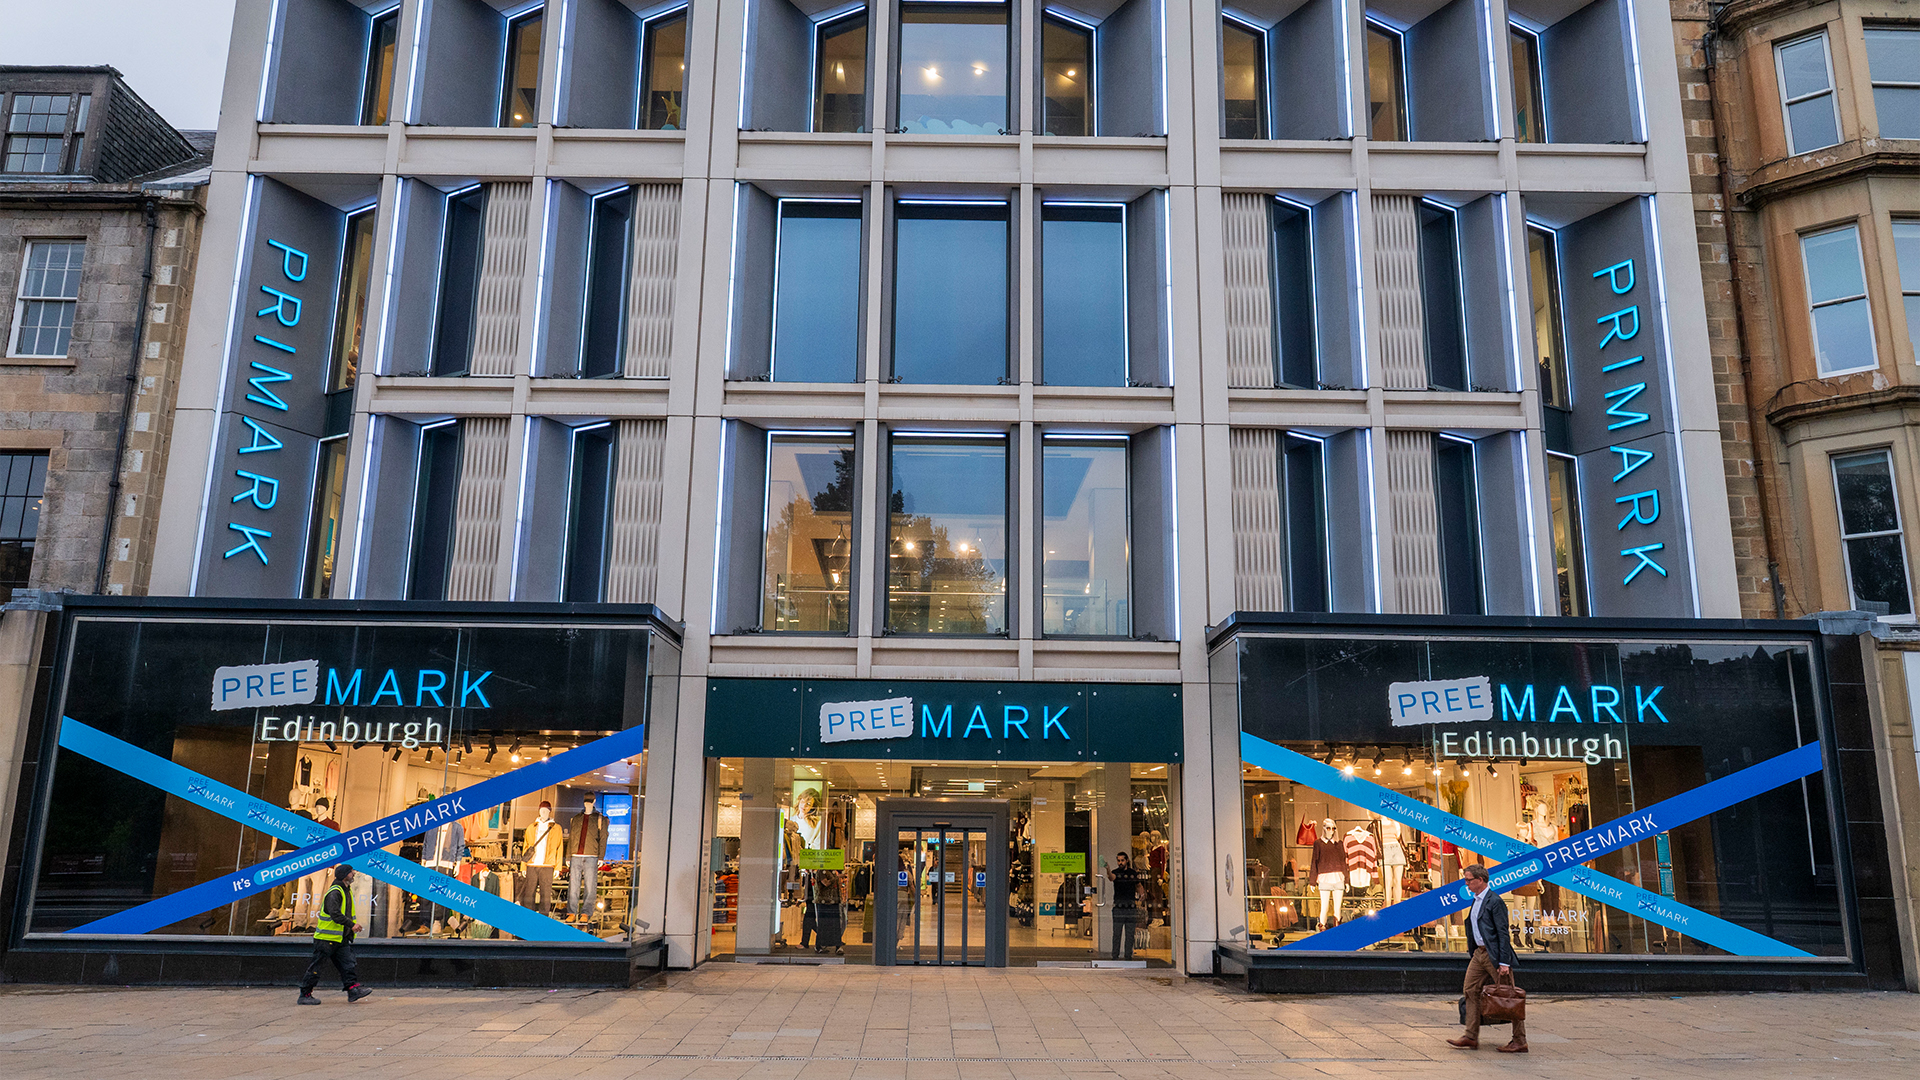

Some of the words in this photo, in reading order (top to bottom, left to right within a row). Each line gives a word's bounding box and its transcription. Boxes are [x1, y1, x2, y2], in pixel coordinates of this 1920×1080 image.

[225, 238, 309, 565] PRIMARK
[1593, 259, 1667, 585] PRIMARK
[222, 669, 308, 701] PREE
[325, 668, 493, 708] MARK
[1398, 685, 1484, 717] PREE
[1500, 684, 1669, 723] MARK
[261, 716, 442, 749] Edinburgh
[828, 705, 906, 734] PREE
[922, 704, 1070, 740] MARK
[1442, 731, 1622, 765] Edinburgh
[232, 878, 251, 892] It's
[260, 847, 338, 882] Pronounced
[346, 796, 466, 853] PREEMARK
[1439, 892, 1459, 907] It's
[1465, 861, 1538, 897] Pnounced
[1544, 813, 1659, 868] PREEMARK
[1508, 909, 1589, 922] REEMARK
[1538, 927, 1569, 935] YEARS
